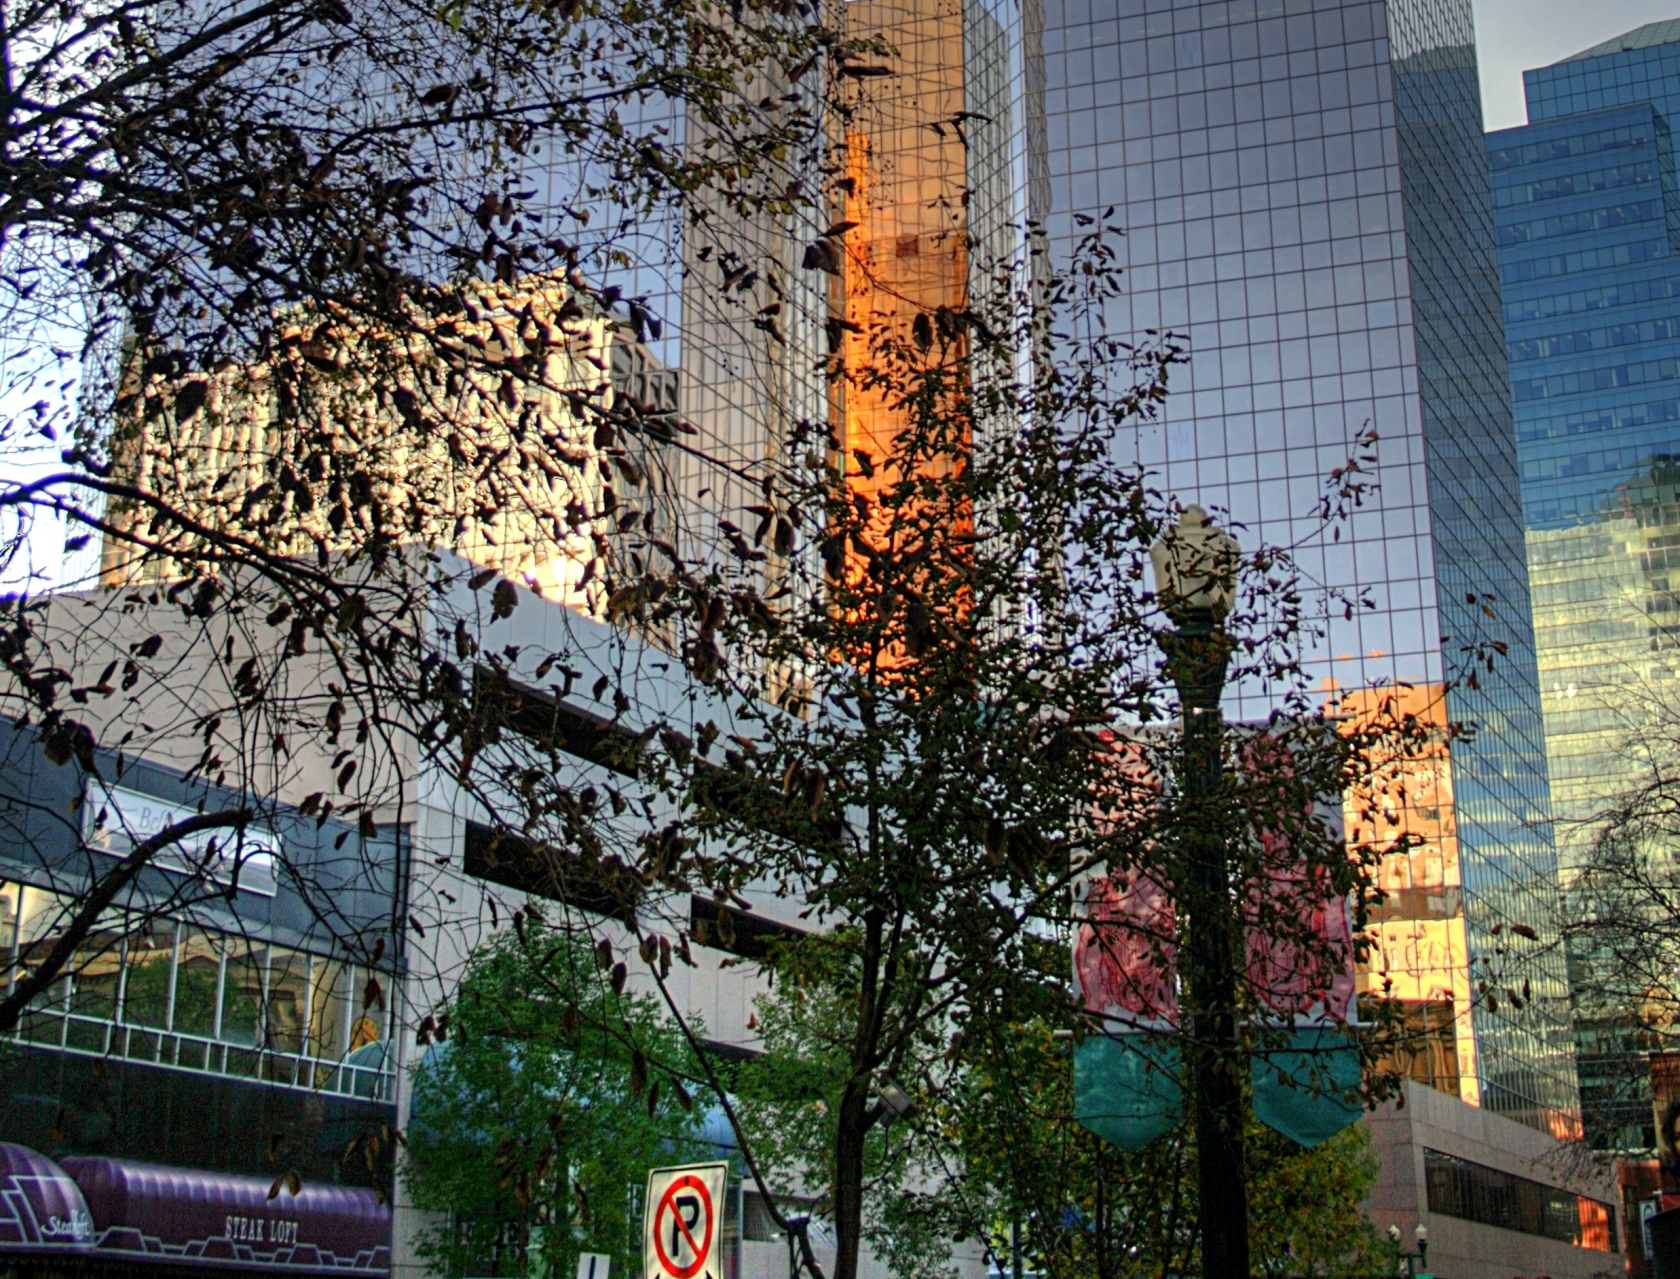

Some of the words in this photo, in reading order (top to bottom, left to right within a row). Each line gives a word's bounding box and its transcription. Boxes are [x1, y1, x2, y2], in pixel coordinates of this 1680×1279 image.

[225, 1215, 265, 1241] STEAK
[270, 1219, 299, 1244] LOFT
[672, 1195, 700, 1257] P
